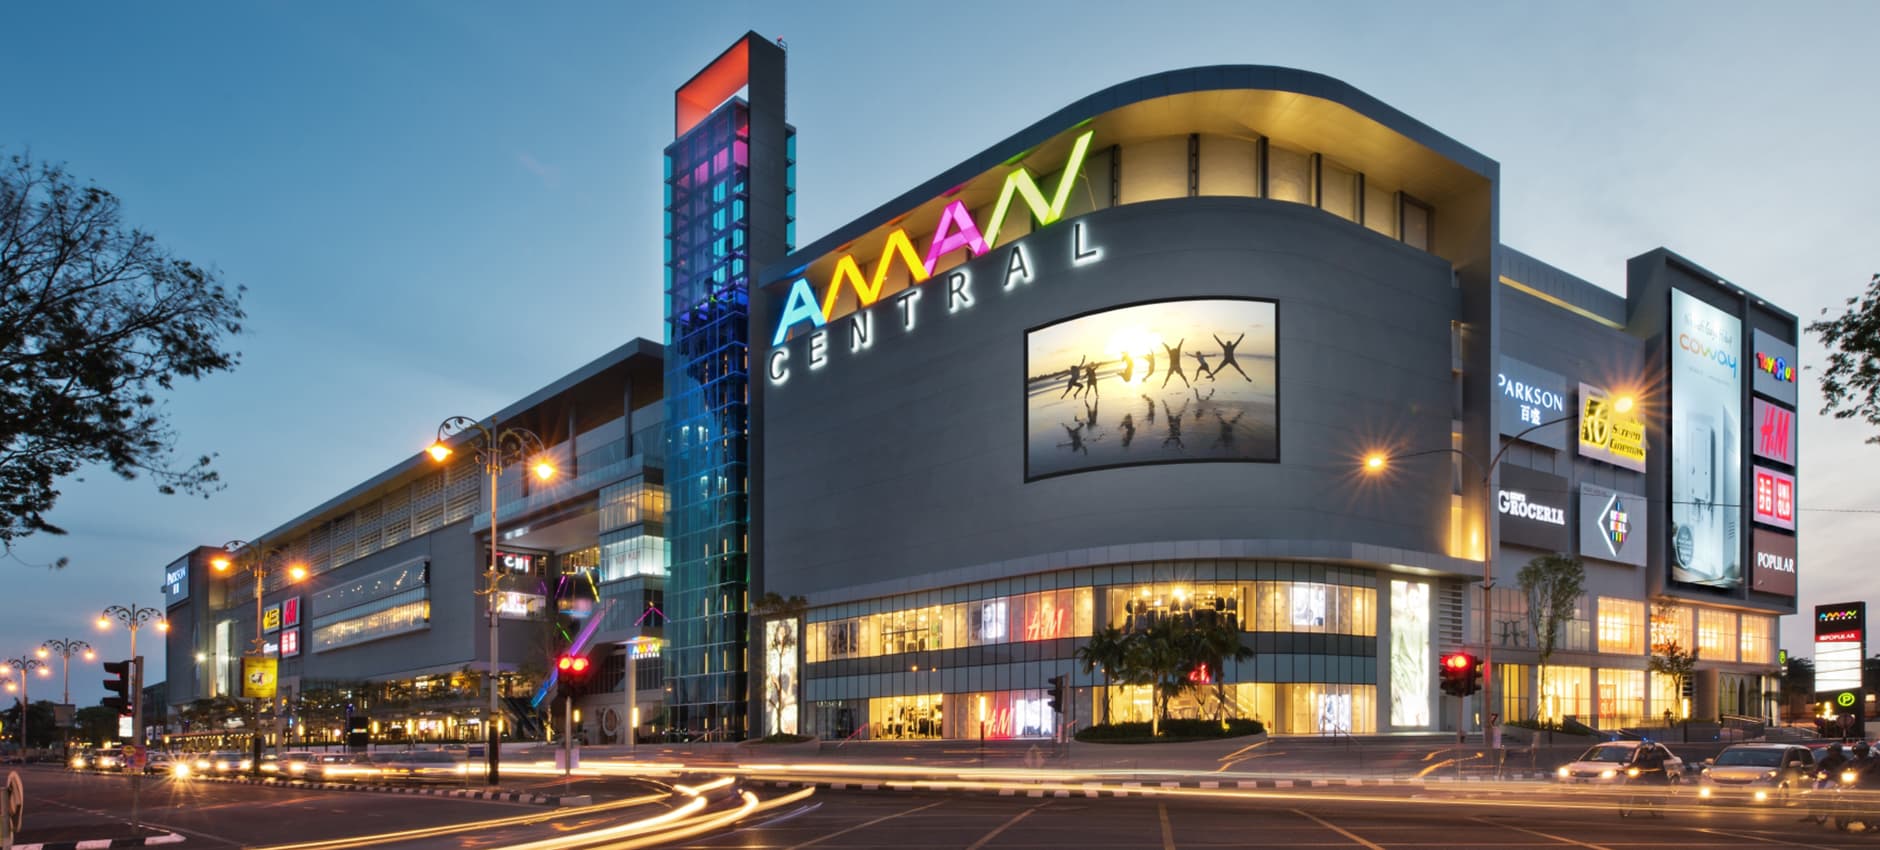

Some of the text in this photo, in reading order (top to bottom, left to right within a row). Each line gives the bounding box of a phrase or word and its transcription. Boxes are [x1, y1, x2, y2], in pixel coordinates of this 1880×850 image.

[772, 130, 1094, 346] AMAN
[768, 222, 1103, 384] CENTRAL
[1679, 333, 1737, 379] coway
[1497, 373, 1563, 412] PARKSON
[1759, 403, 1790, 461] H&M
[1757, 552, 1795, 574] POPULAR
[1028, 608, 1064, 640] H&M
